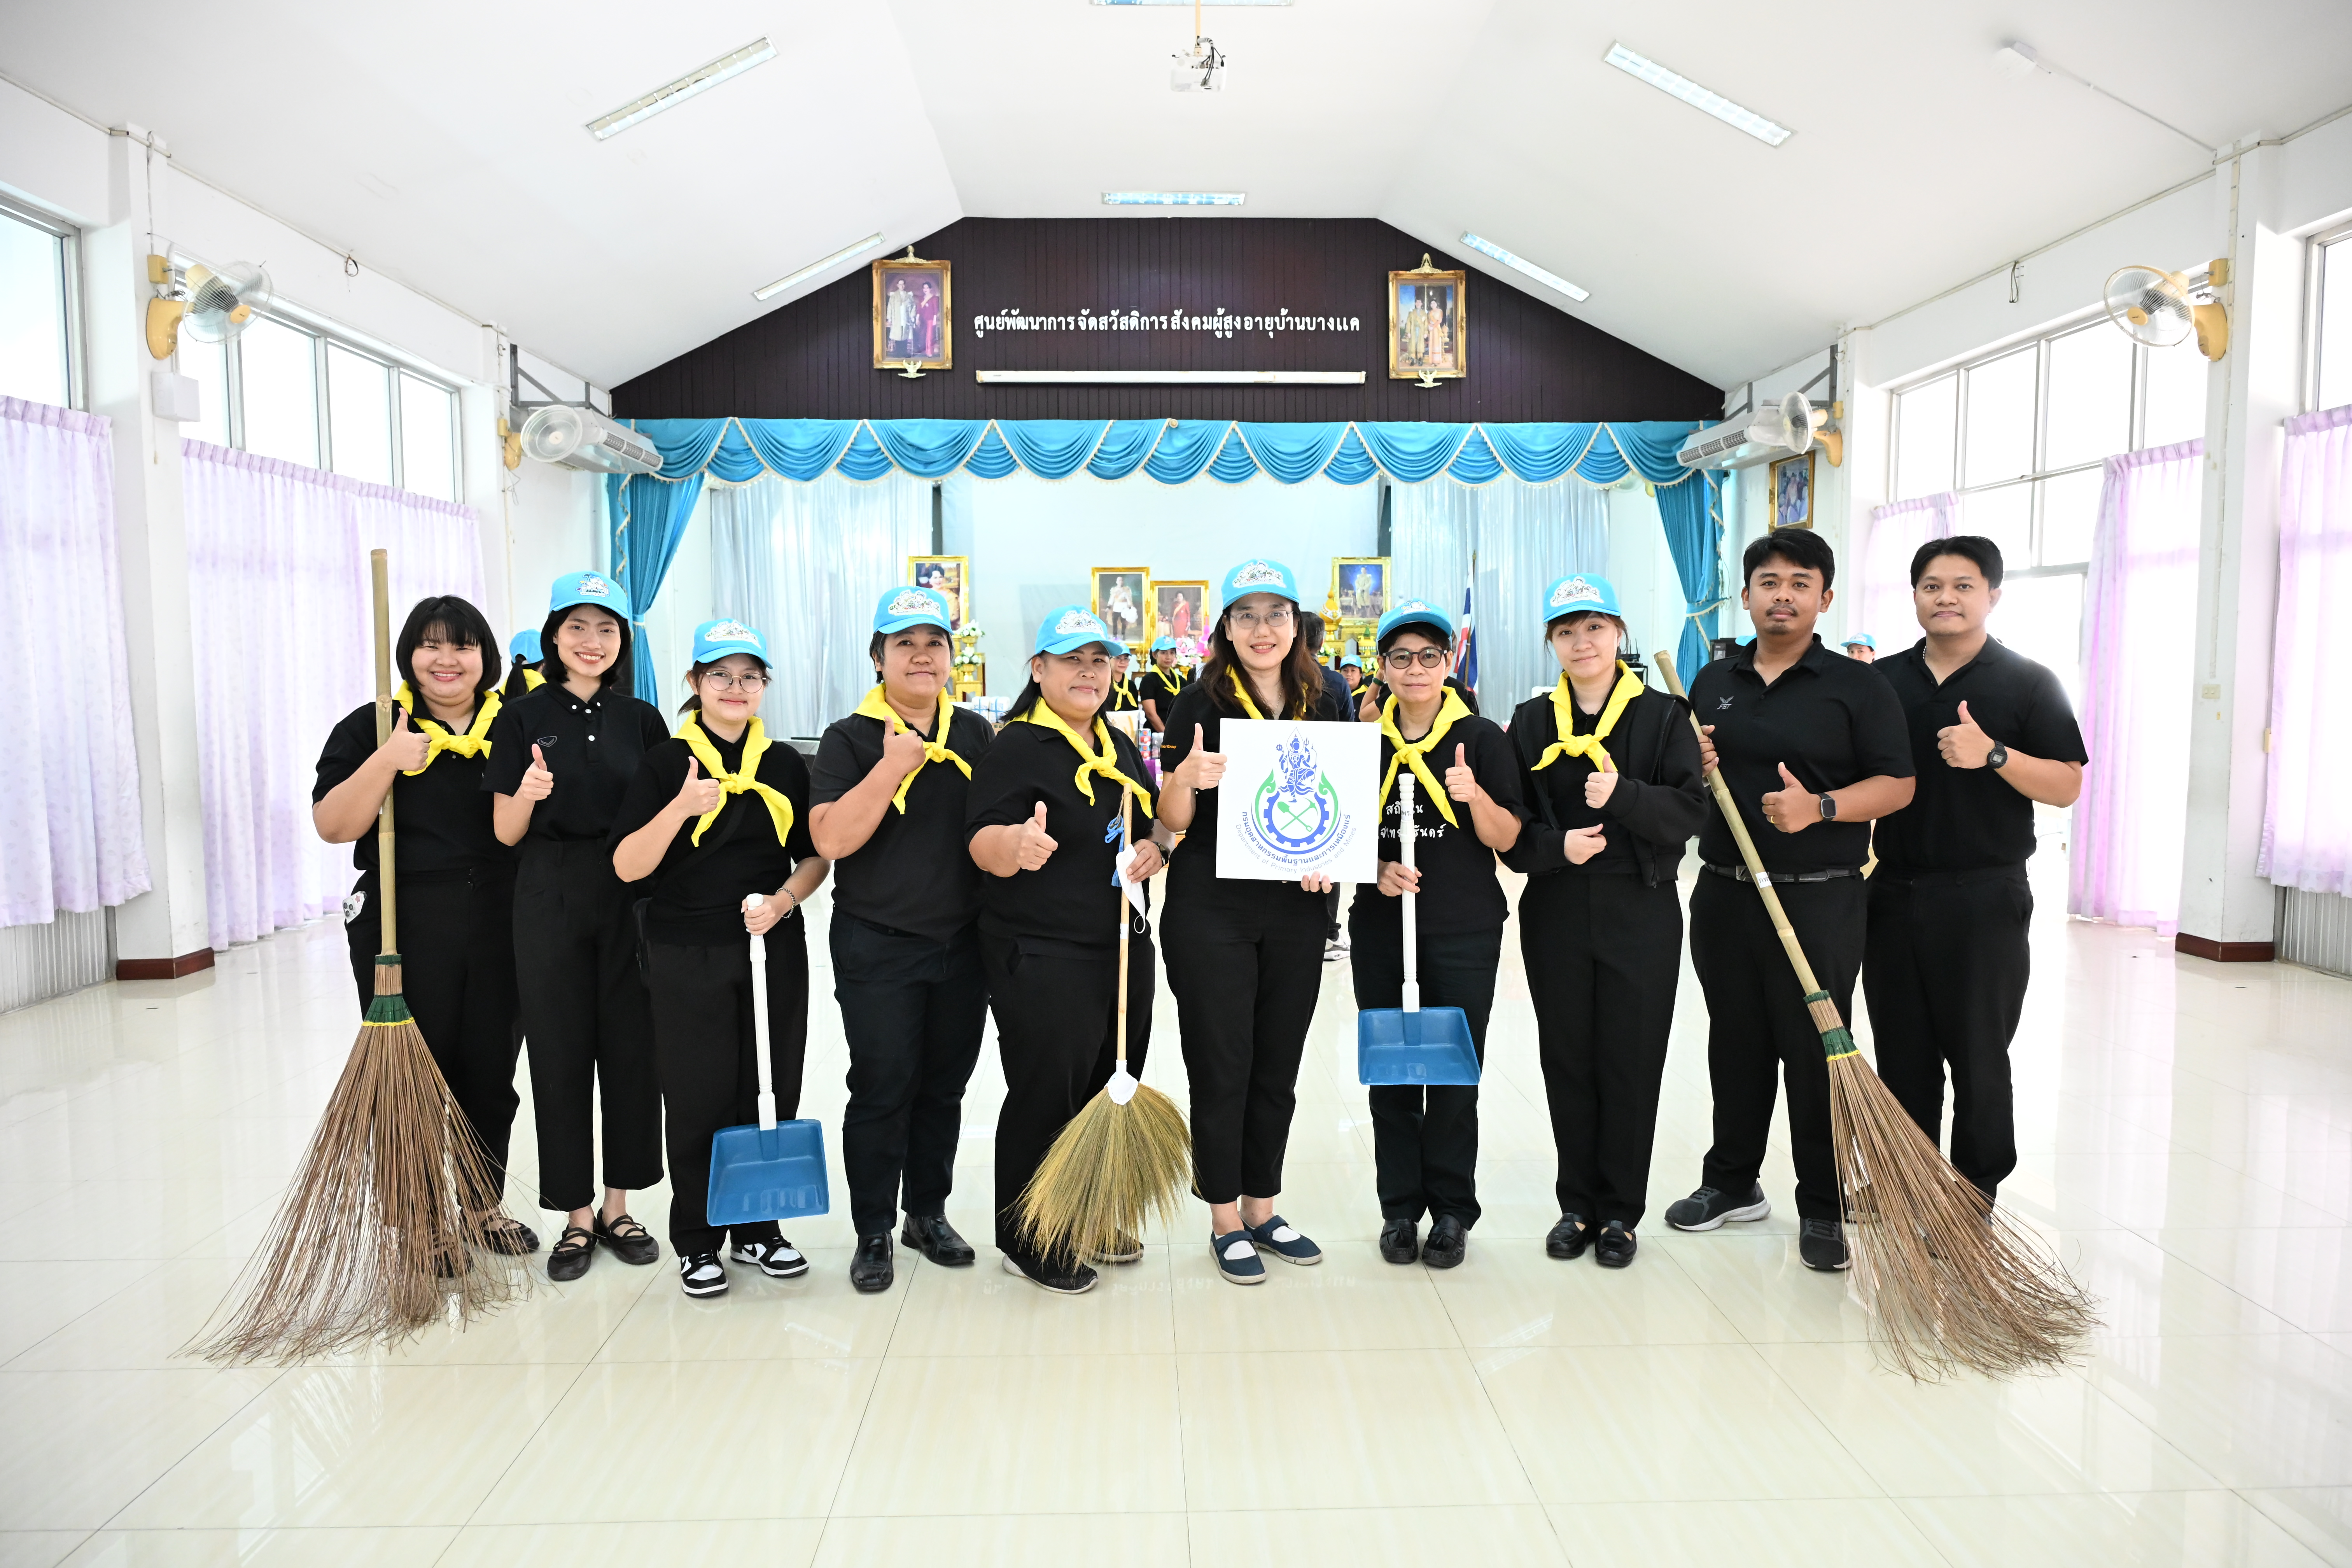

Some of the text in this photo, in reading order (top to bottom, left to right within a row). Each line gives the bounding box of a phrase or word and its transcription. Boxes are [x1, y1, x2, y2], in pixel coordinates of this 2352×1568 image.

[1236, 824, 1260, 859] Department
[1270, 862, 1297, 874] Primary
[1300, 858, 1332, 872] Industries
[1334, 847, 1344, 858] and
[1343, 827, 1356, 847] Mines
